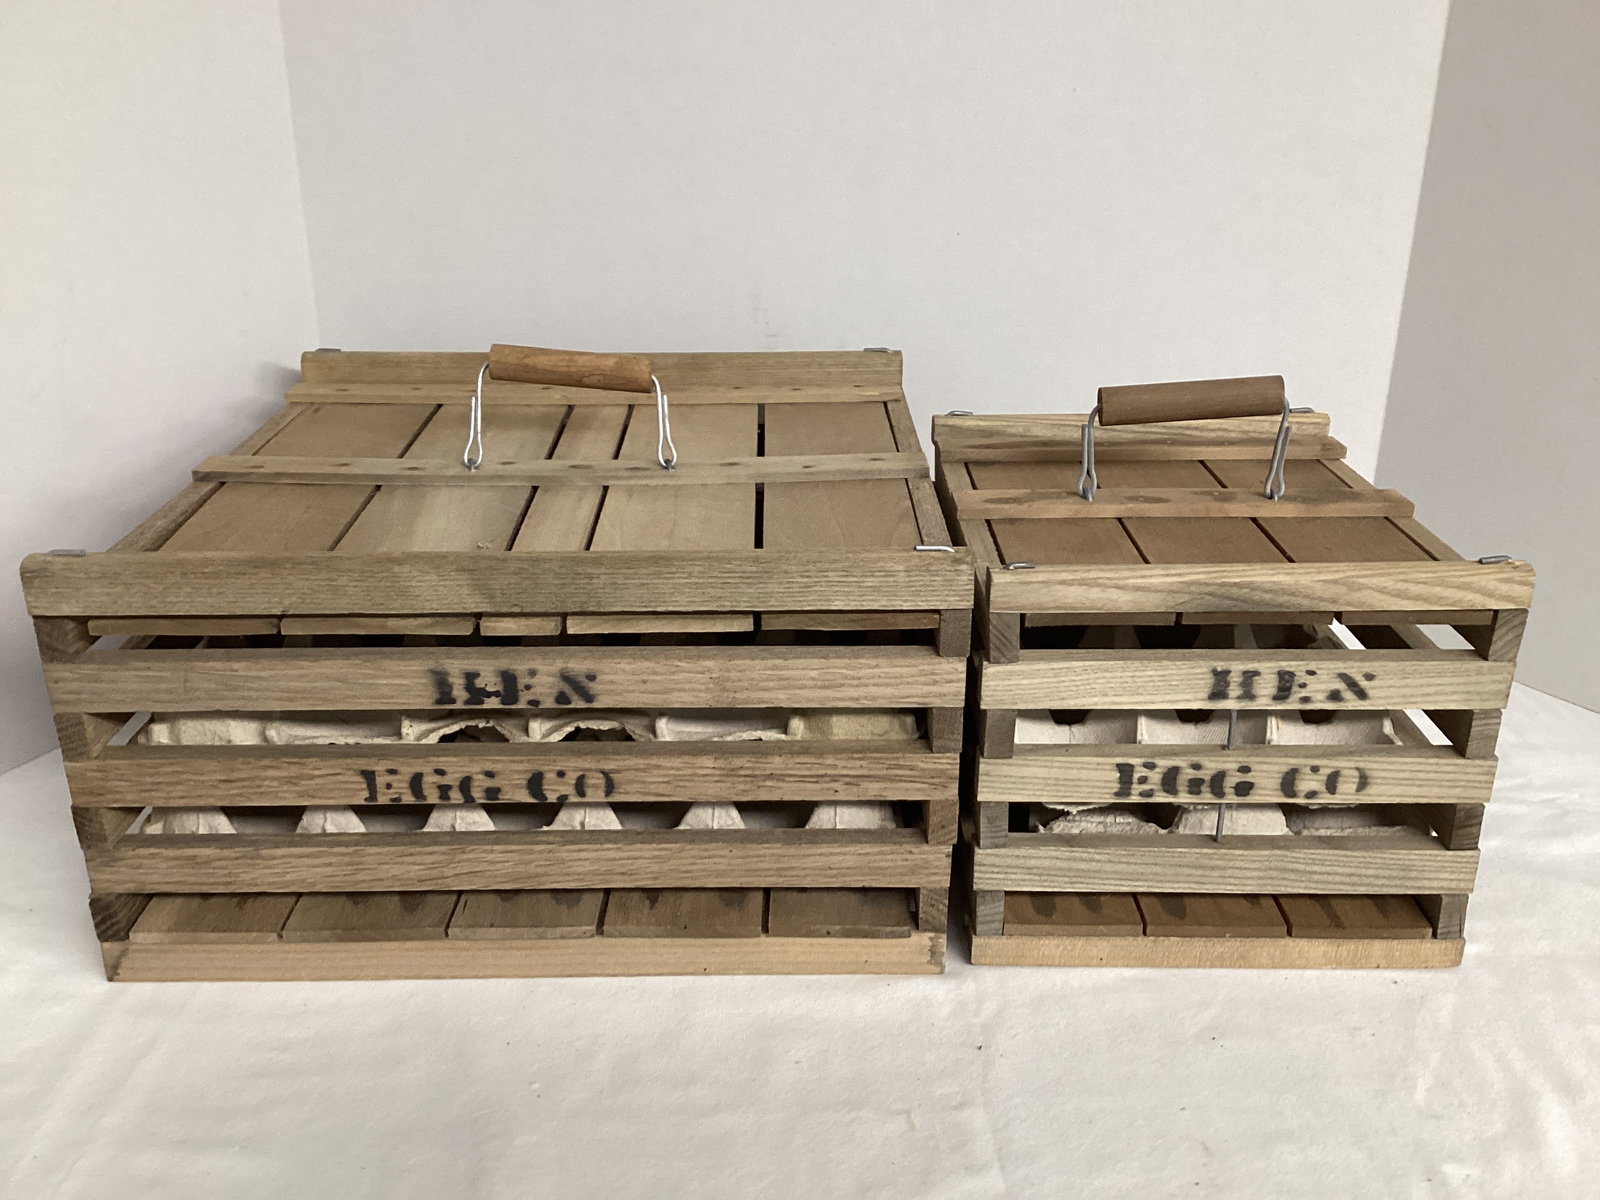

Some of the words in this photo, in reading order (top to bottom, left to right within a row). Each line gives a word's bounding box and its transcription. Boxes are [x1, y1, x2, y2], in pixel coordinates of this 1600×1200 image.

[430, 668, 597, 706] HEN
[1208, 668, 1377, 701] HEN
[361, 769, 501, 803] EGG
[527, 771, 616, 802] CO
[1114, 762, 1255, 798] EGG
[1280, 765, 1369, 799] CO
